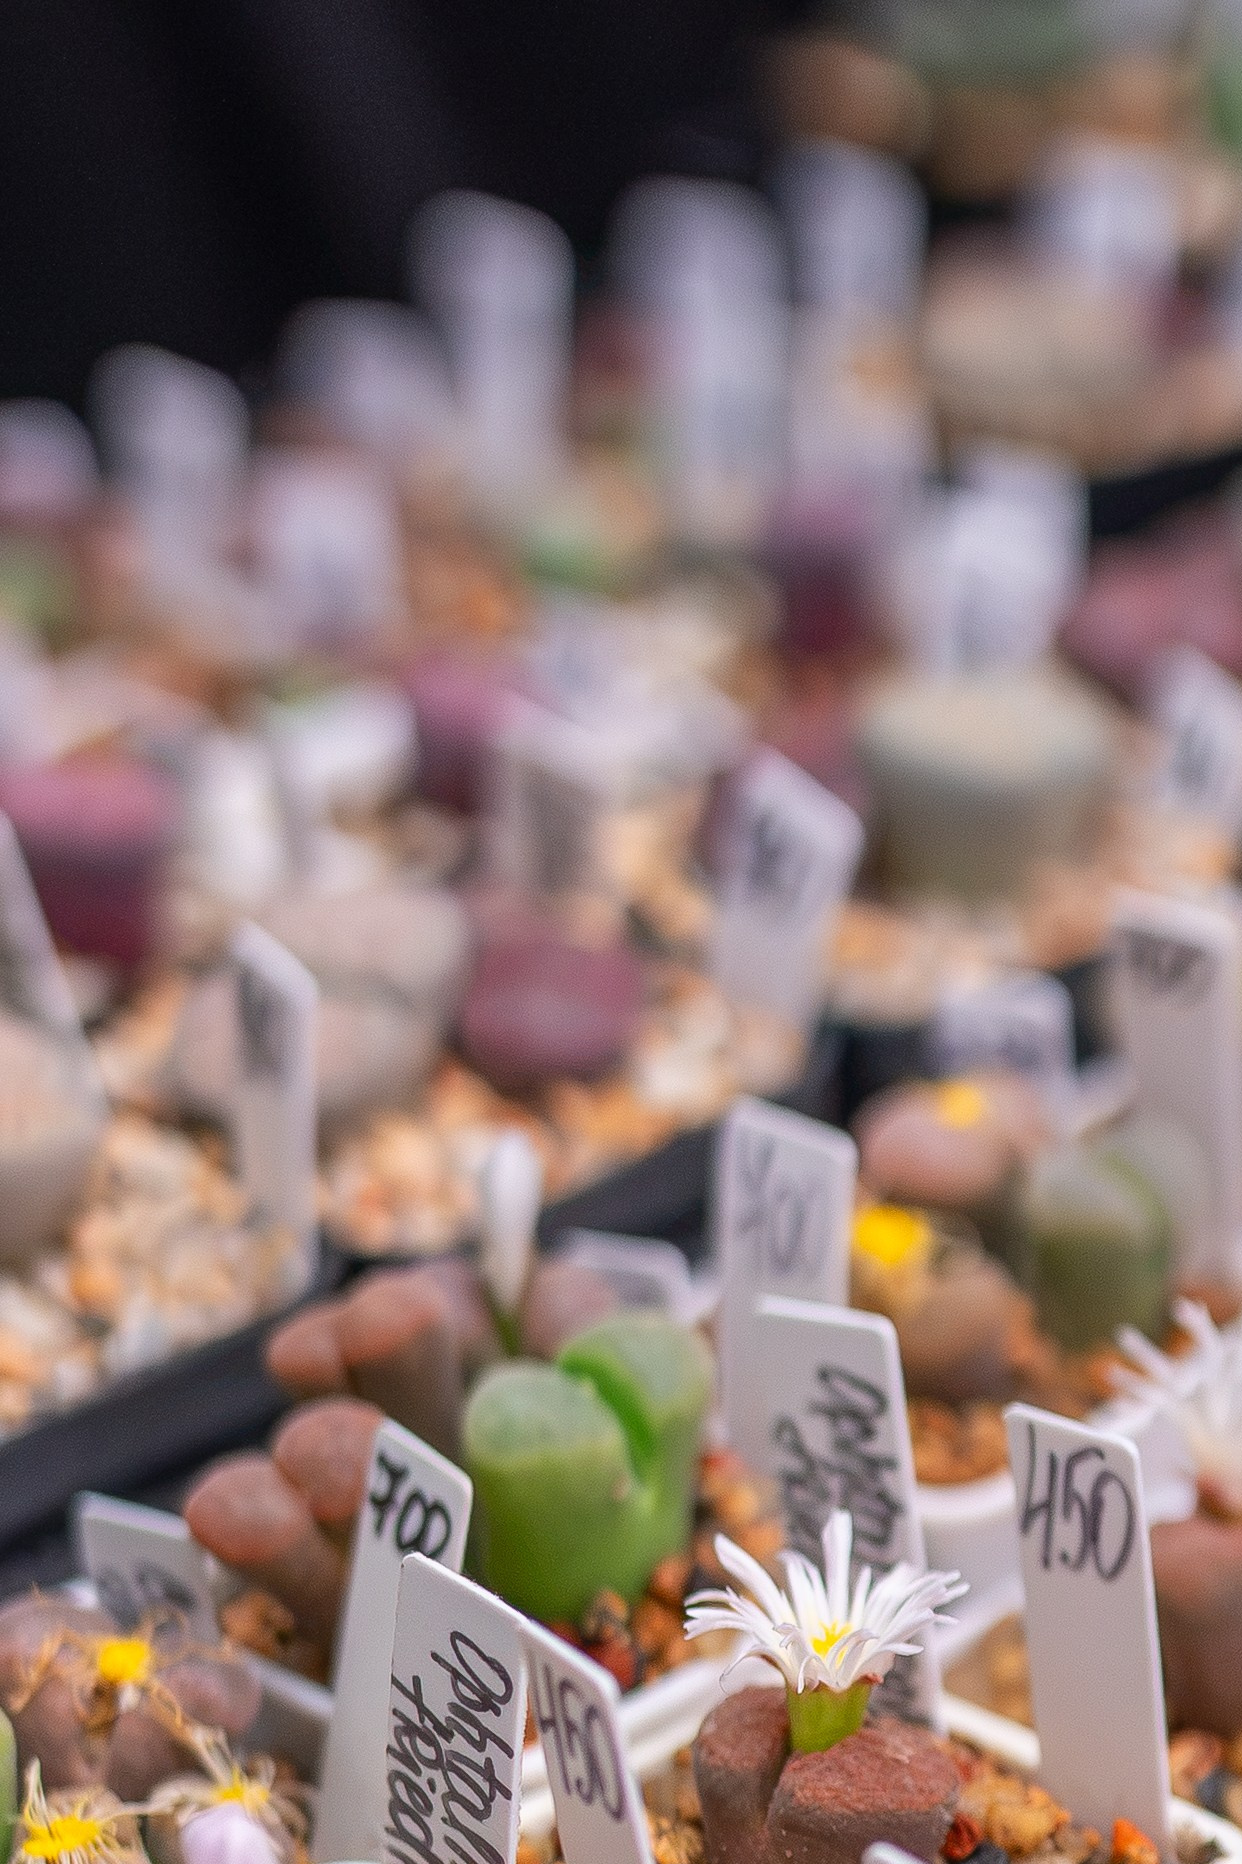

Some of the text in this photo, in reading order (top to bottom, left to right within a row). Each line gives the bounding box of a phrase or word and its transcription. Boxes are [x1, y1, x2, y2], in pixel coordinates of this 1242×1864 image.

[370, 1450, 452, 1558] 700
[1018, 1422, 1136, 1582] 450
[532, 1660, 626, 1821] 450
